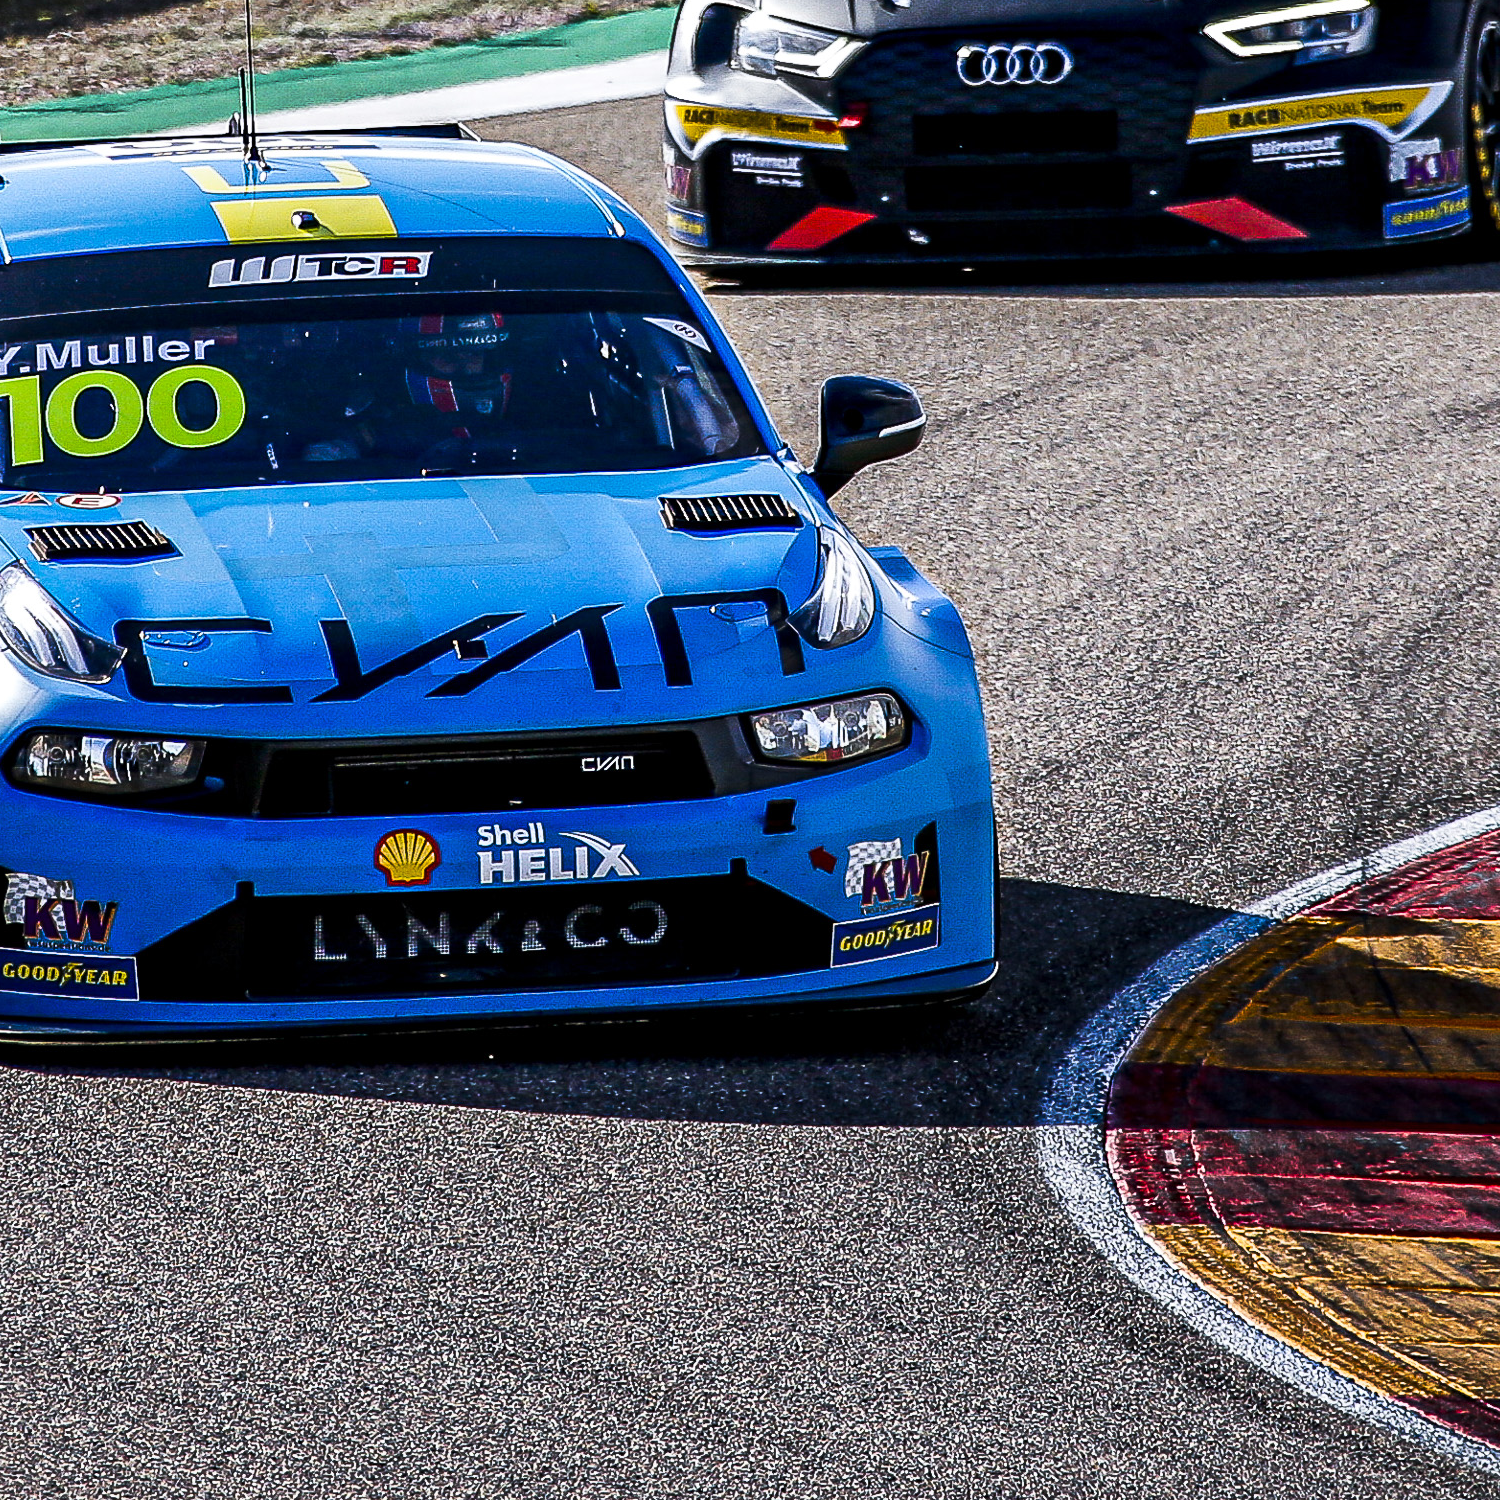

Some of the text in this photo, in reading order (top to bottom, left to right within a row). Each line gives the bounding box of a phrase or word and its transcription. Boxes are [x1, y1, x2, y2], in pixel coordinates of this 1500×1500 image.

[580, 755, 635, 773] CYAN
[477, 822, 545, 847] Shell
[478, 832, 641, 884] HELIX
[860, 850, 930, 907] KW
[23, 896, 119, 945] KW
[839, 918, 934, 952] GOODYEAR
[2, 962, 128, 987] GOODYEAR
